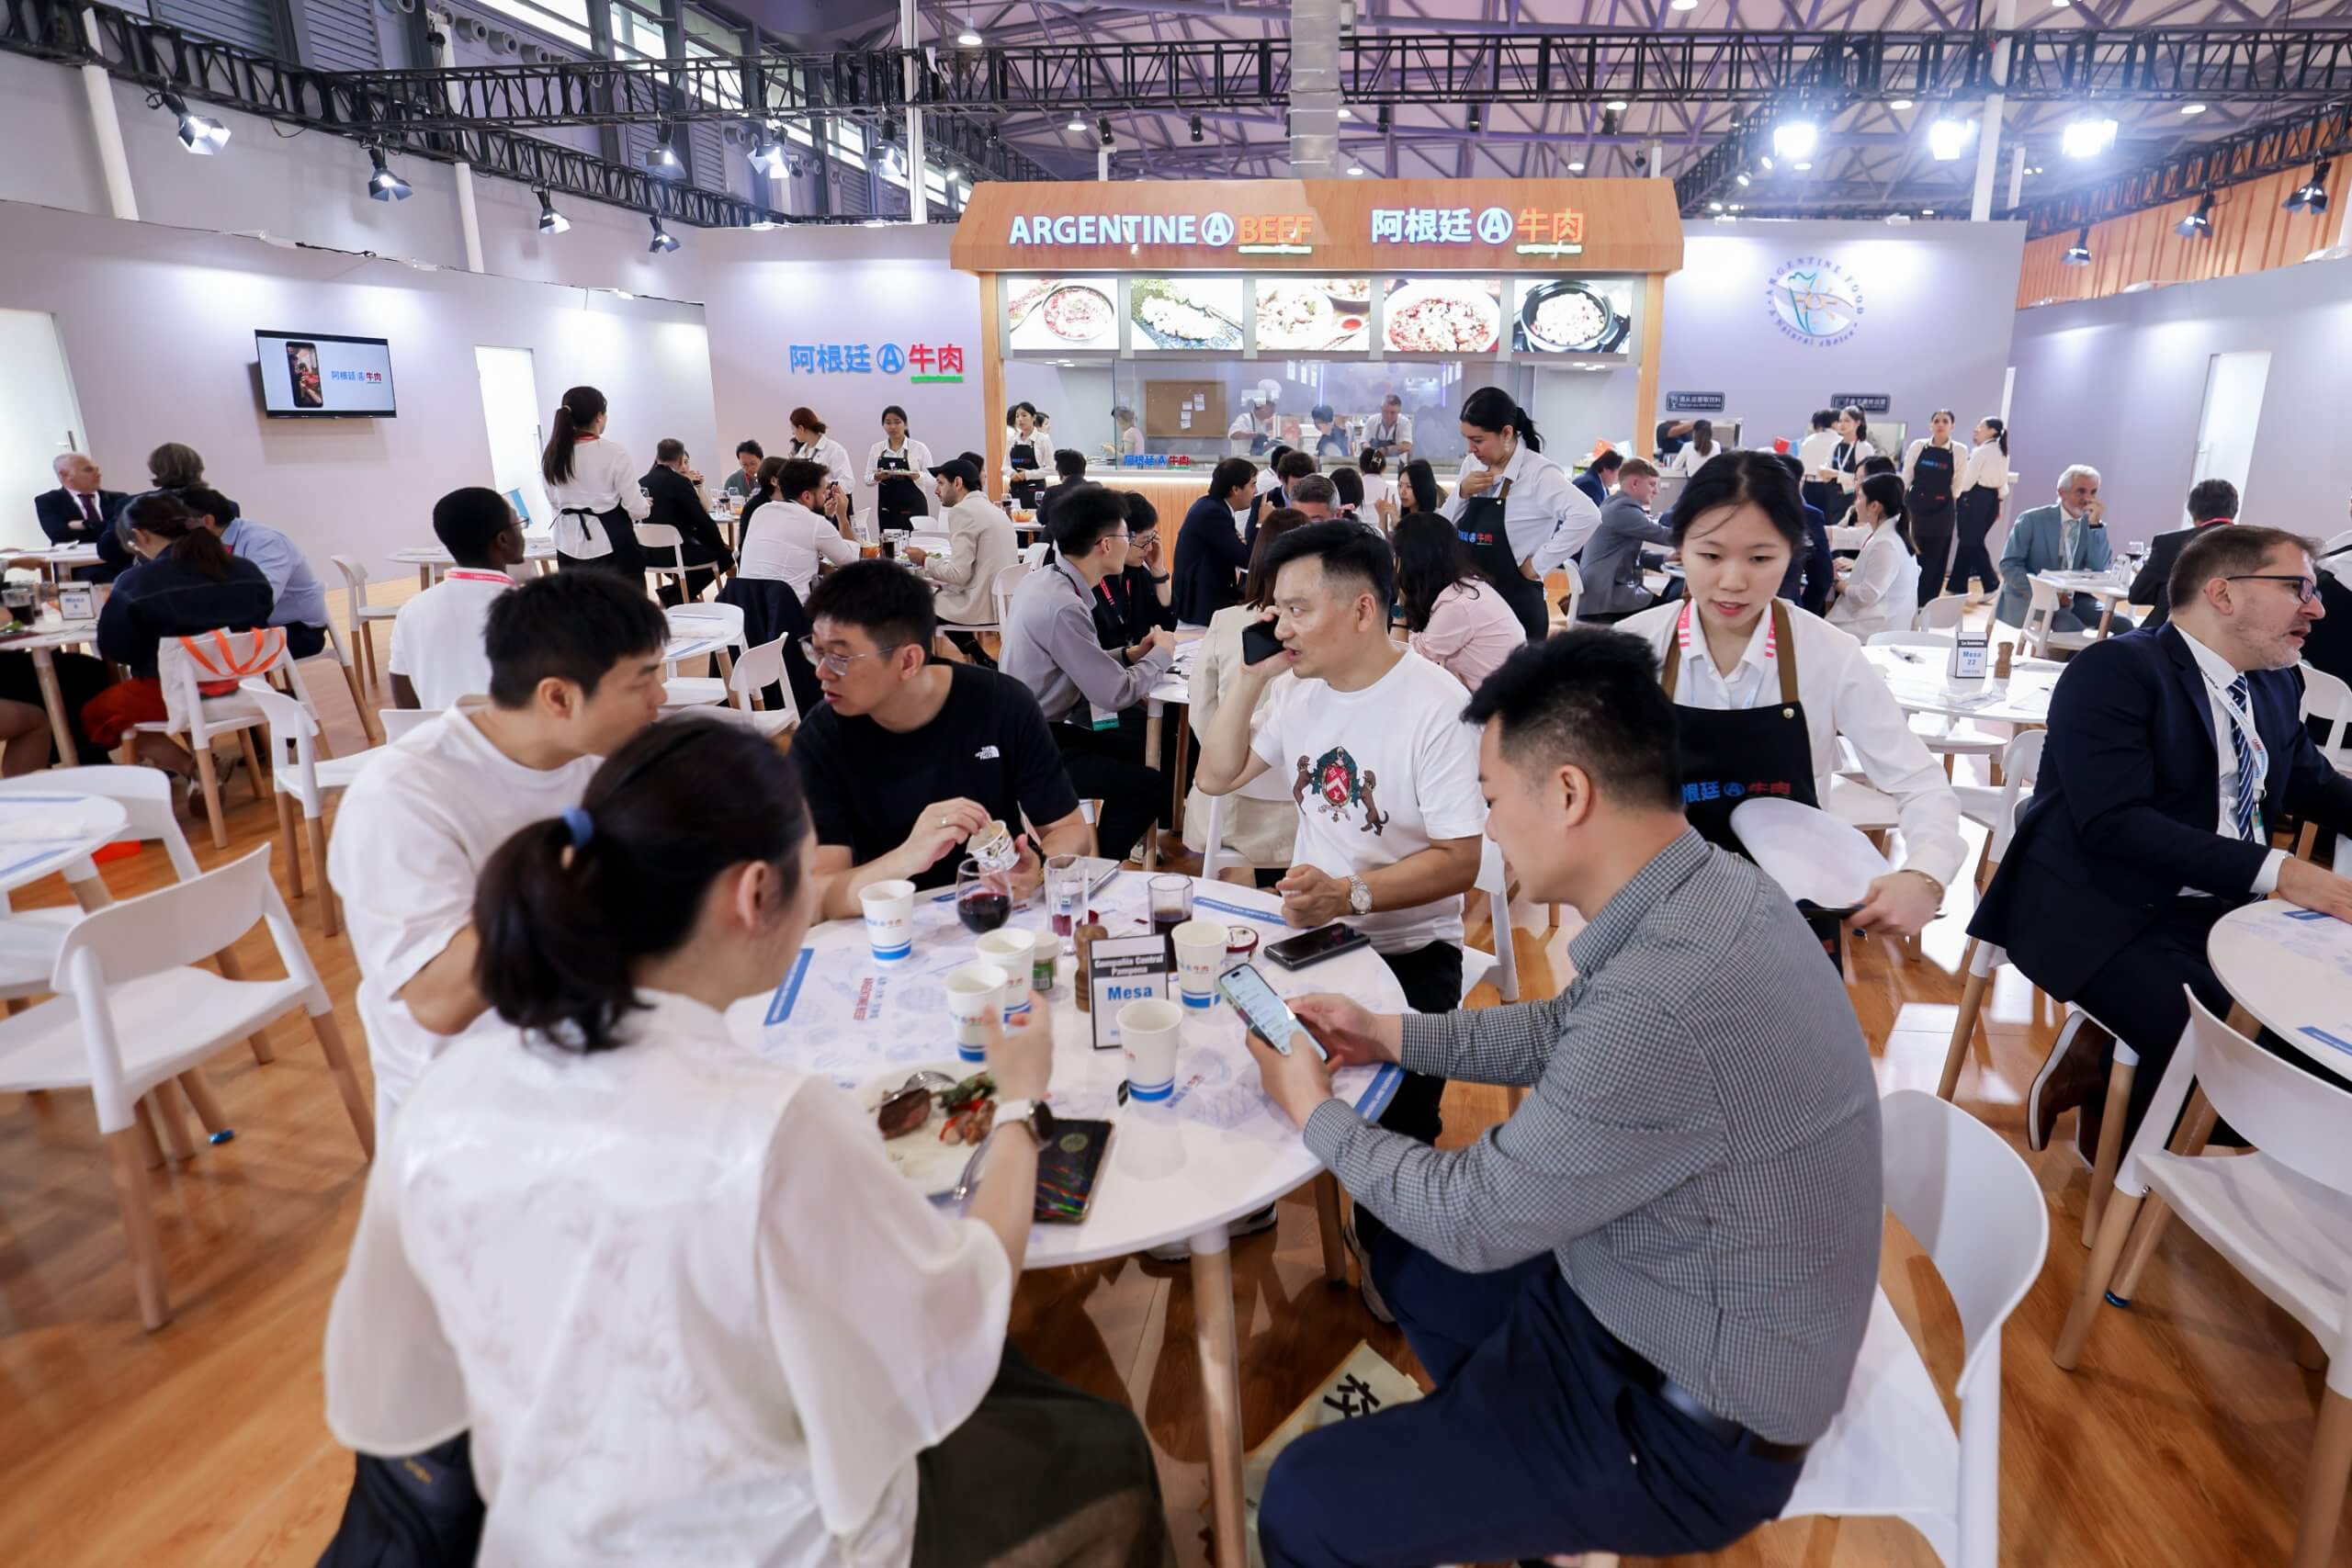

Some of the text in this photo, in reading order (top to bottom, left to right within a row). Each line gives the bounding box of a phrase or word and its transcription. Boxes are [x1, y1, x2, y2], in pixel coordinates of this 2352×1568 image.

[1009, 215, 1197, 245] ARGENTINE
[1239, 216, 1312, 243] BEEF
[1372, 208, 1472, 243] 阿根廷
[1517, 208, 1584, 243] 牛肉
[1766, 256, 1843, 296] ARGENTINE
[789, 344, 871, 375] 阿根廷
[909, 344, 963, 374] 牛肉
[1135, 954, 1164, 965] Central
[1107, 986, 1153, 1000] Mesa
